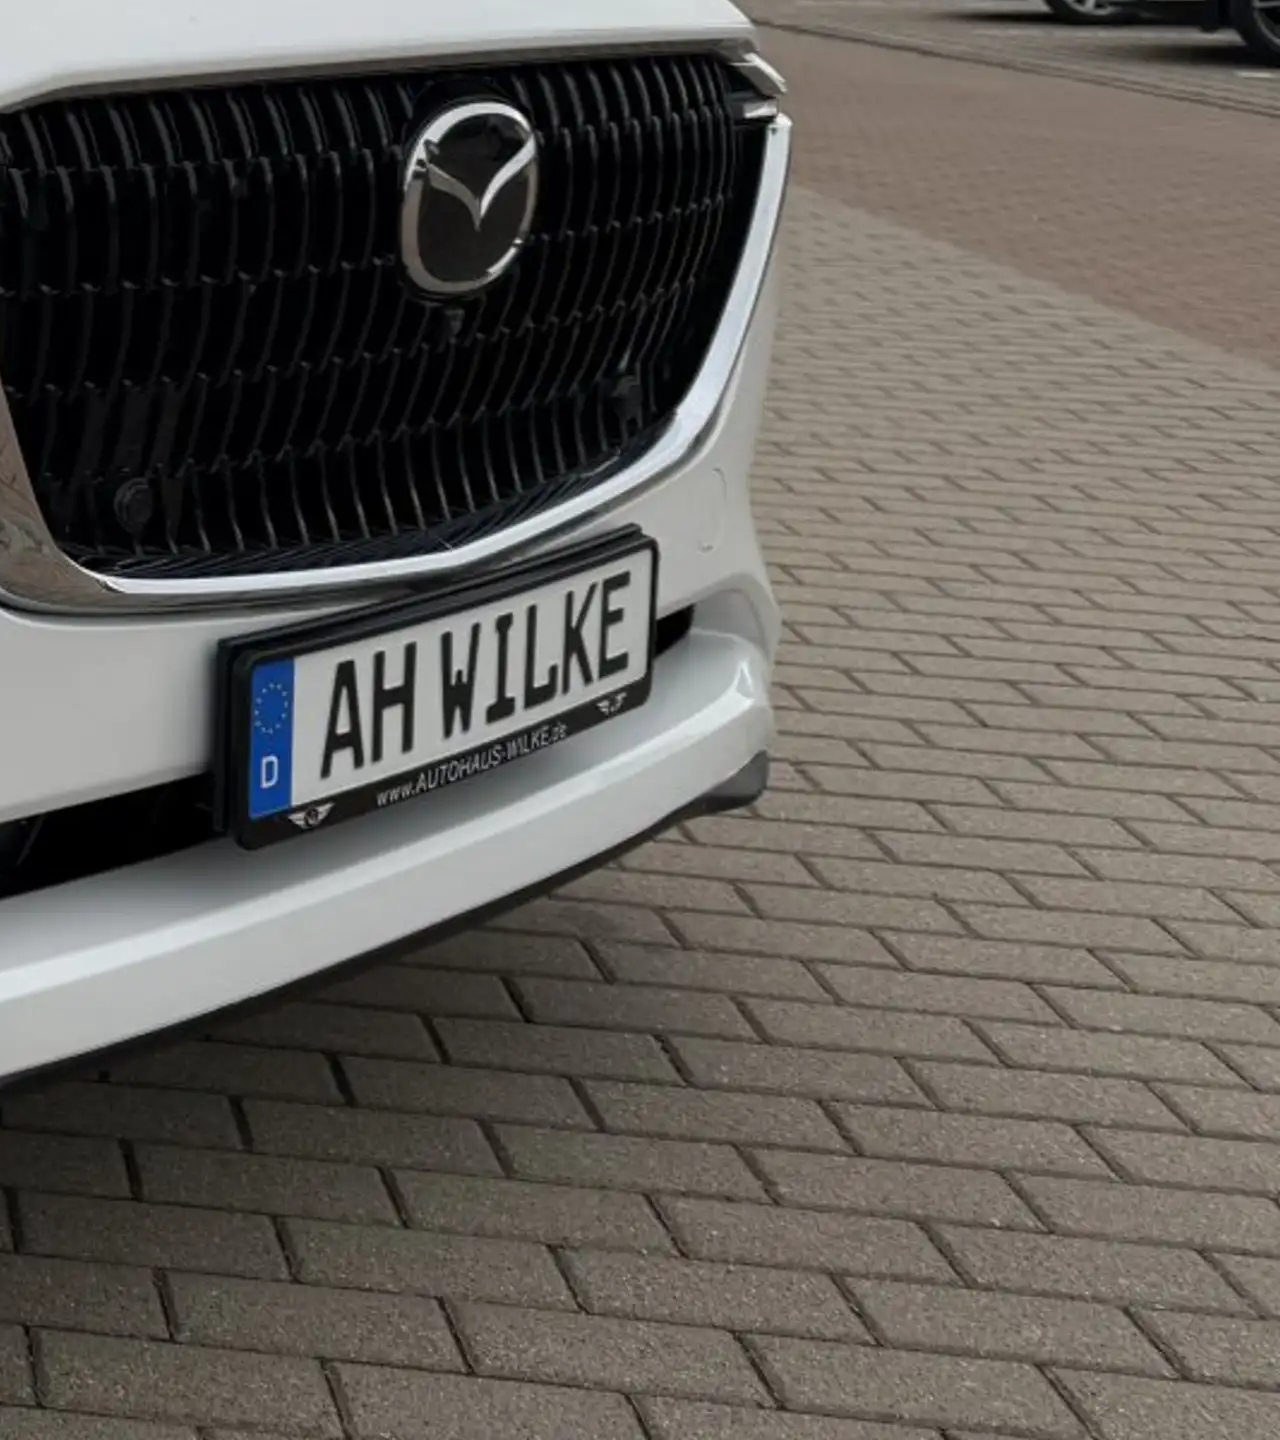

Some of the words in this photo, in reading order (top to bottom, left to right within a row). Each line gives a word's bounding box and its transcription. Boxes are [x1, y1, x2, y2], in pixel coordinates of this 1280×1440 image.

[320, 641, 418, 779] AH
[440, 571, 631, 739] WILKE
[260, 755, 279, 789] D
